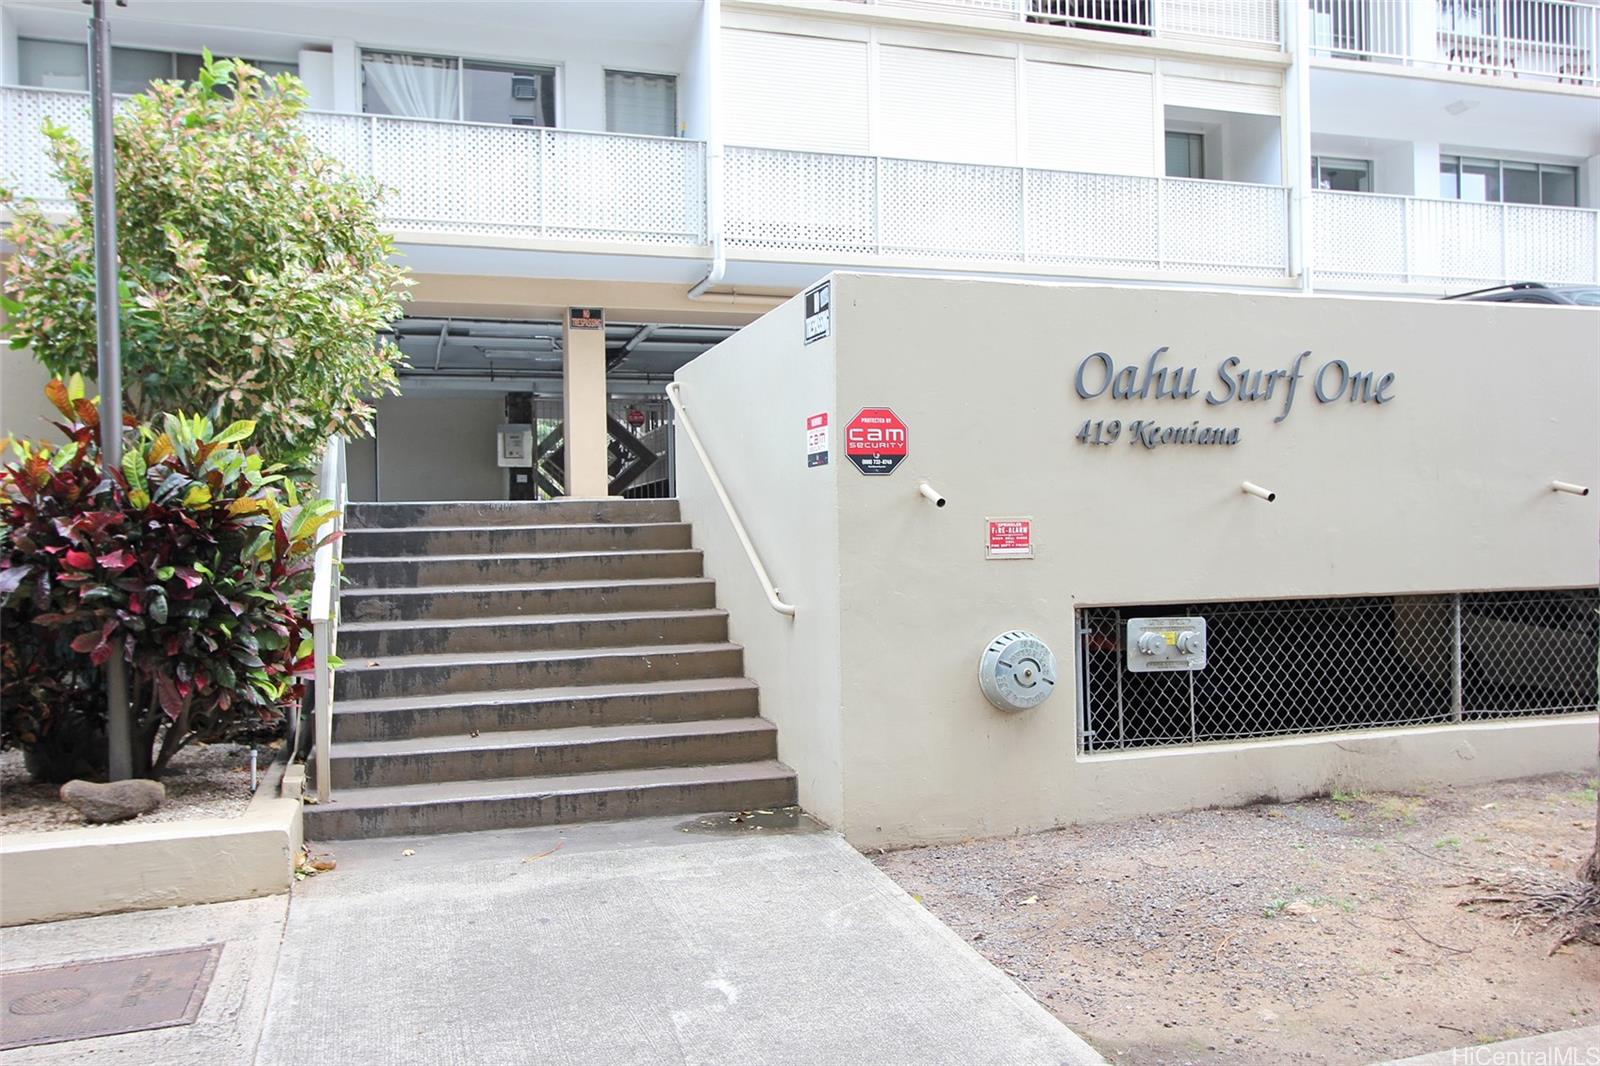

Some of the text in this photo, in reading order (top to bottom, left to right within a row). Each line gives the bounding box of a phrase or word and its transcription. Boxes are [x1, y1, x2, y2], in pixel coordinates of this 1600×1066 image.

[1075, 346, 1396, 423] Oahu Surf One
[1075, 419, 1241, 449] 419 Keoniana
